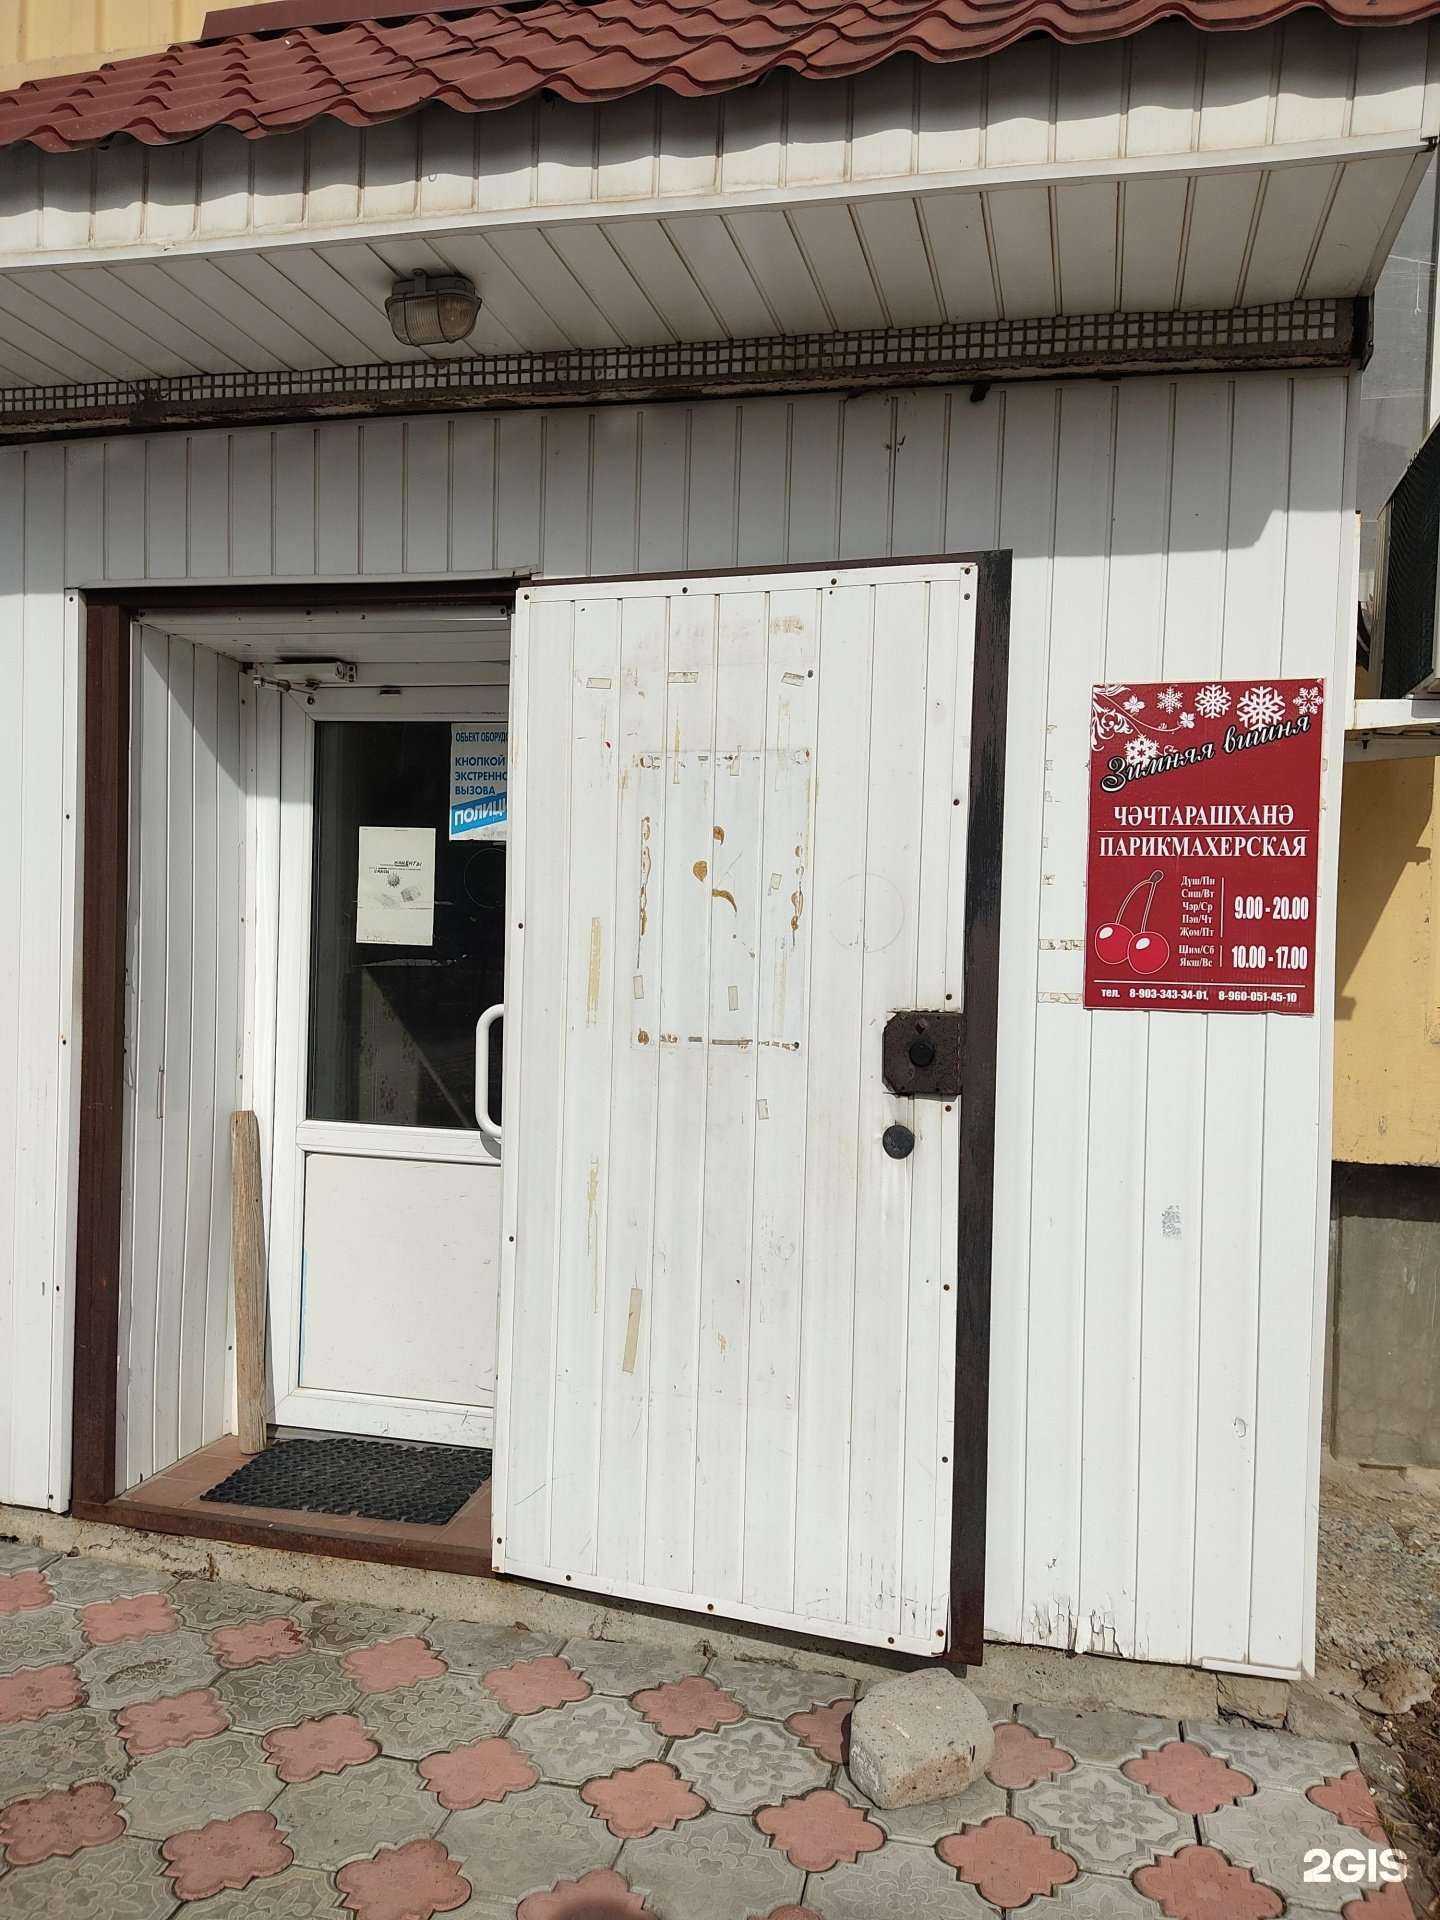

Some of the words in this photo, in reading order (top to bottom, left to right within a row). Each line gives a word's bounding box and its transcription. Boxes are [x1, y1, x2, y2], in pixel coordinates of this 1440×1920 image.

[455, 755, 506, 767] КНОПКОЙ
[1101, 742, 1215, 793] Зимняя
[1223, 715, 1311, 754] вишня
[455, 786, 496, 796] ВЫЗОВА
[1113, 804, 1295, 827] ЧӘЧТАРАШХАНӘ
[1099, 836, 1308, 858] ПАРИКМАХЕРСКАЯ
[1234, 896, 1264, 920] 9.00
[1272, 896, 1310, 921] 20.00
[1178, 944, 1215, 955] Шим/Сб
[1231, 945, 1267, 969] 10.00
[1275, 945, 1308, 970] 17.00
[1179, 957, 1213, 968] Якш/Вс
[1101, 989, 1120, 998] тел.
[1218, 991, 1297, 1003] 8-960-051-45-10
